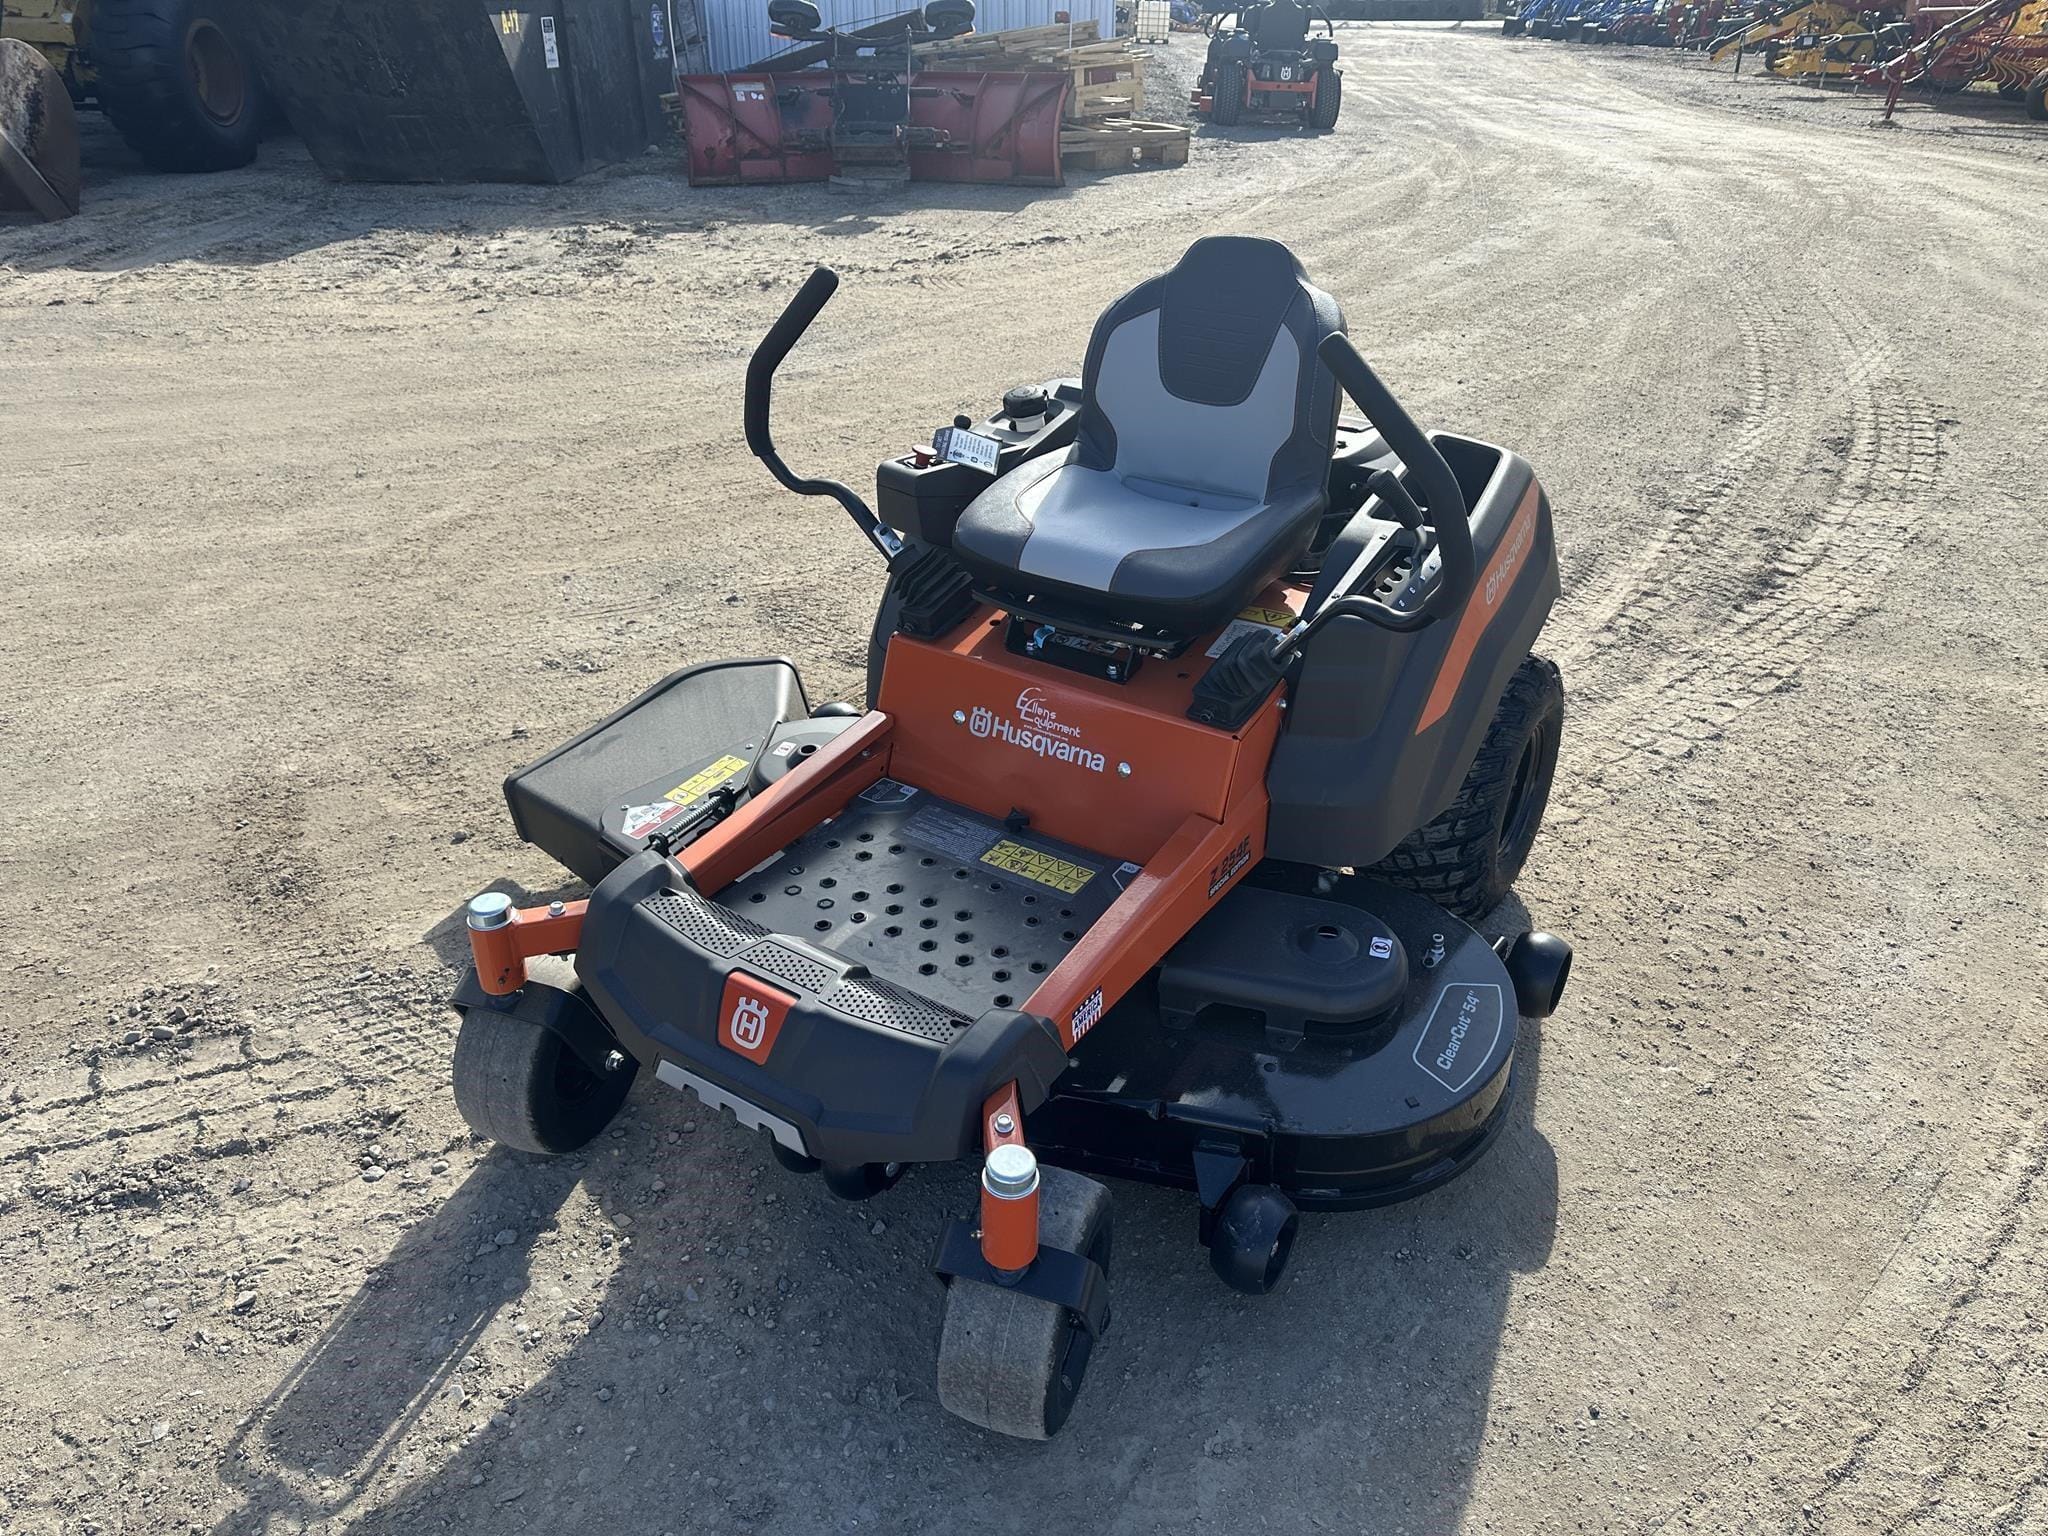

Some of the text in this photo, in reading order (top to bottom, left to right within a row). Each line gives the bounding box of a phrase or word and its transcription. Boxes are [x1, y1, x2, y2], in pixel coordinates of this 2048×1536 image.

[1493, 513, 1531, 589] Husqvarna
[1016, 687, 1057, 720] Ellens
[1020, 698, 1081, 738] Equipment
[991, 716, 1106, 772] Husqvarna
[1074, 995, 1101, 1031] AMERICA
